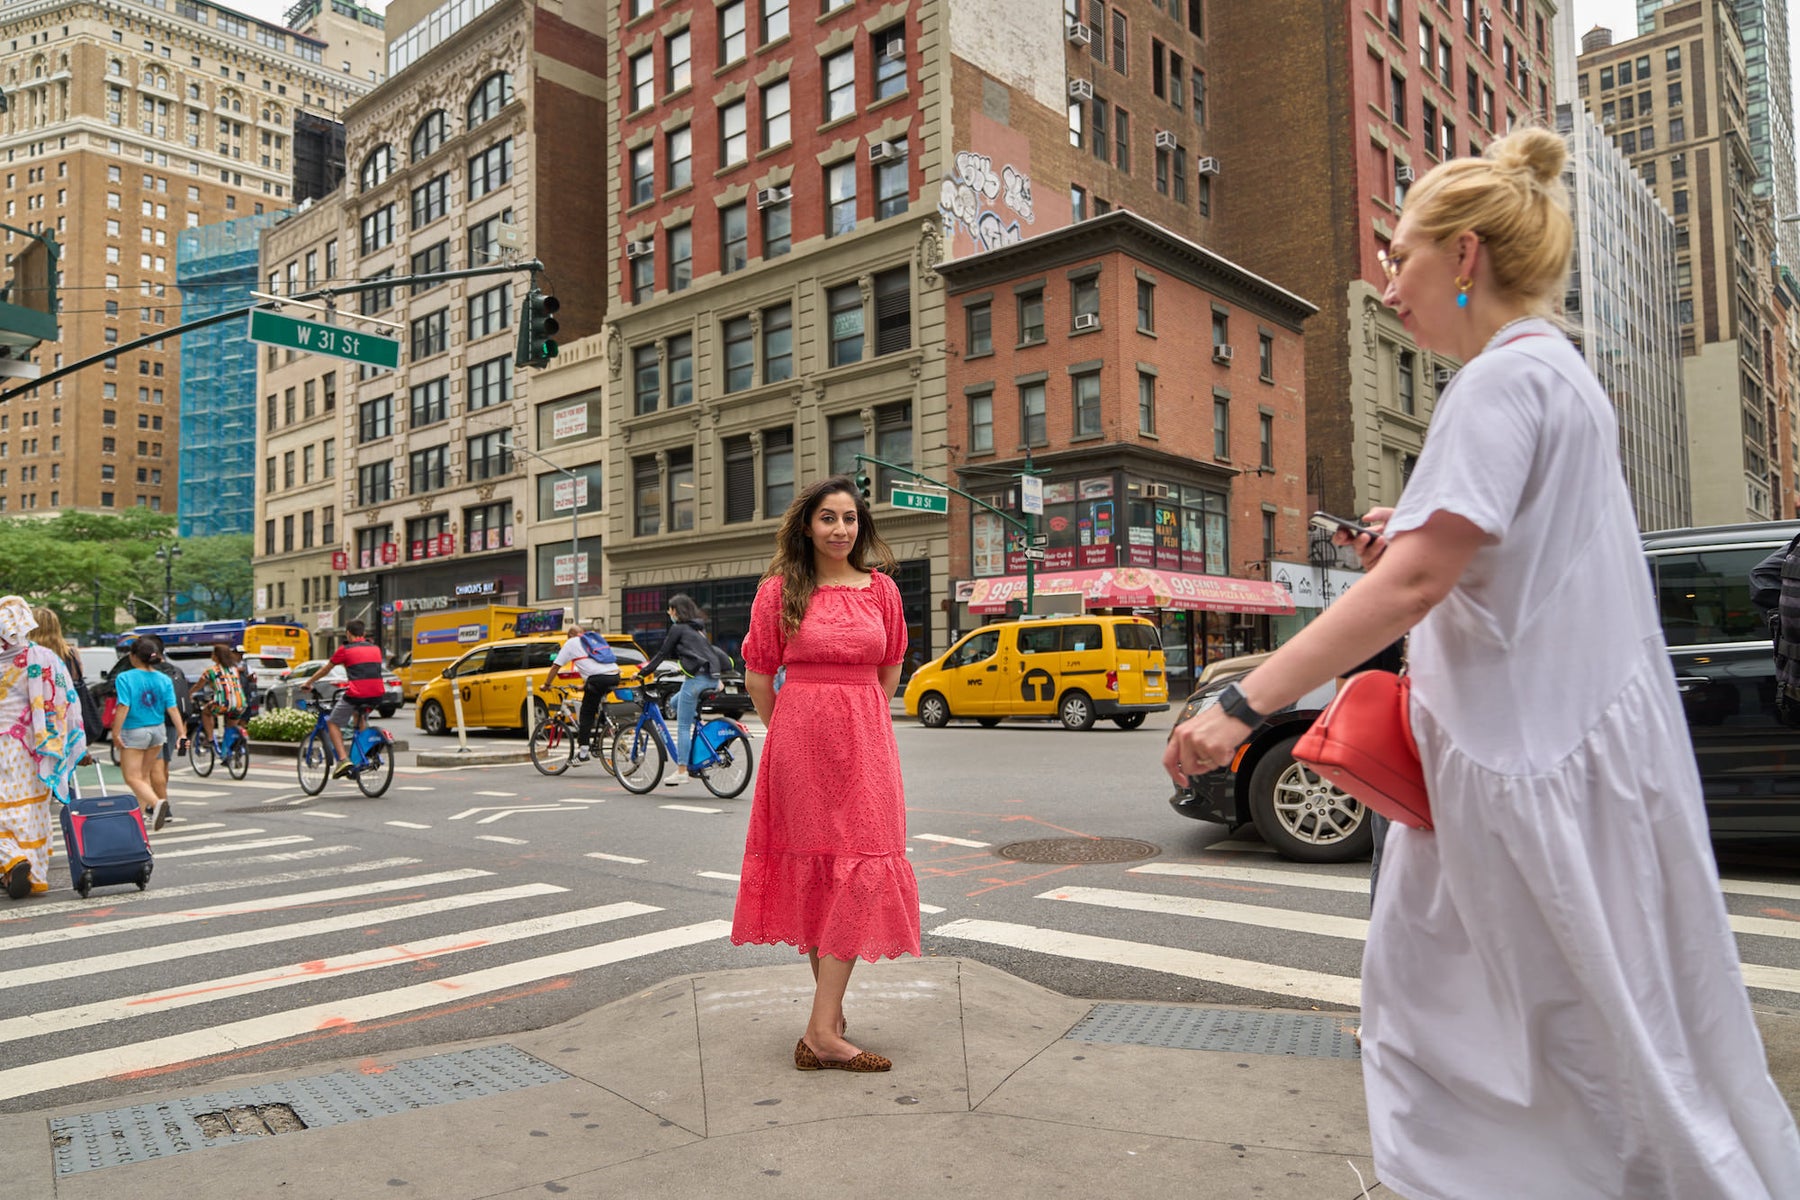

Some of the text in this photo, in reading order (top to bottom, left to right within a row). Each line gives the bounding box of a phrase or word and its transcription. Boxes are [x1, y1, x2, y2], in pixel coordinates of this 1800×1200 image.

[297, 325, 360, 355] W 31 St
[907, 495, 932, 508] W 31 St
[1156, 509, 1177, 526] SPA
[1156, 525, 1172, 535] MANI
[1163, 536, 1178, 548] PEDI
[1086, 548, 1106, 556] Herbal
[989, 582, 1014, 601] 99
[1171, 577, 1195, 596] 99
[1193, 579, 1220, 589] CENTS
